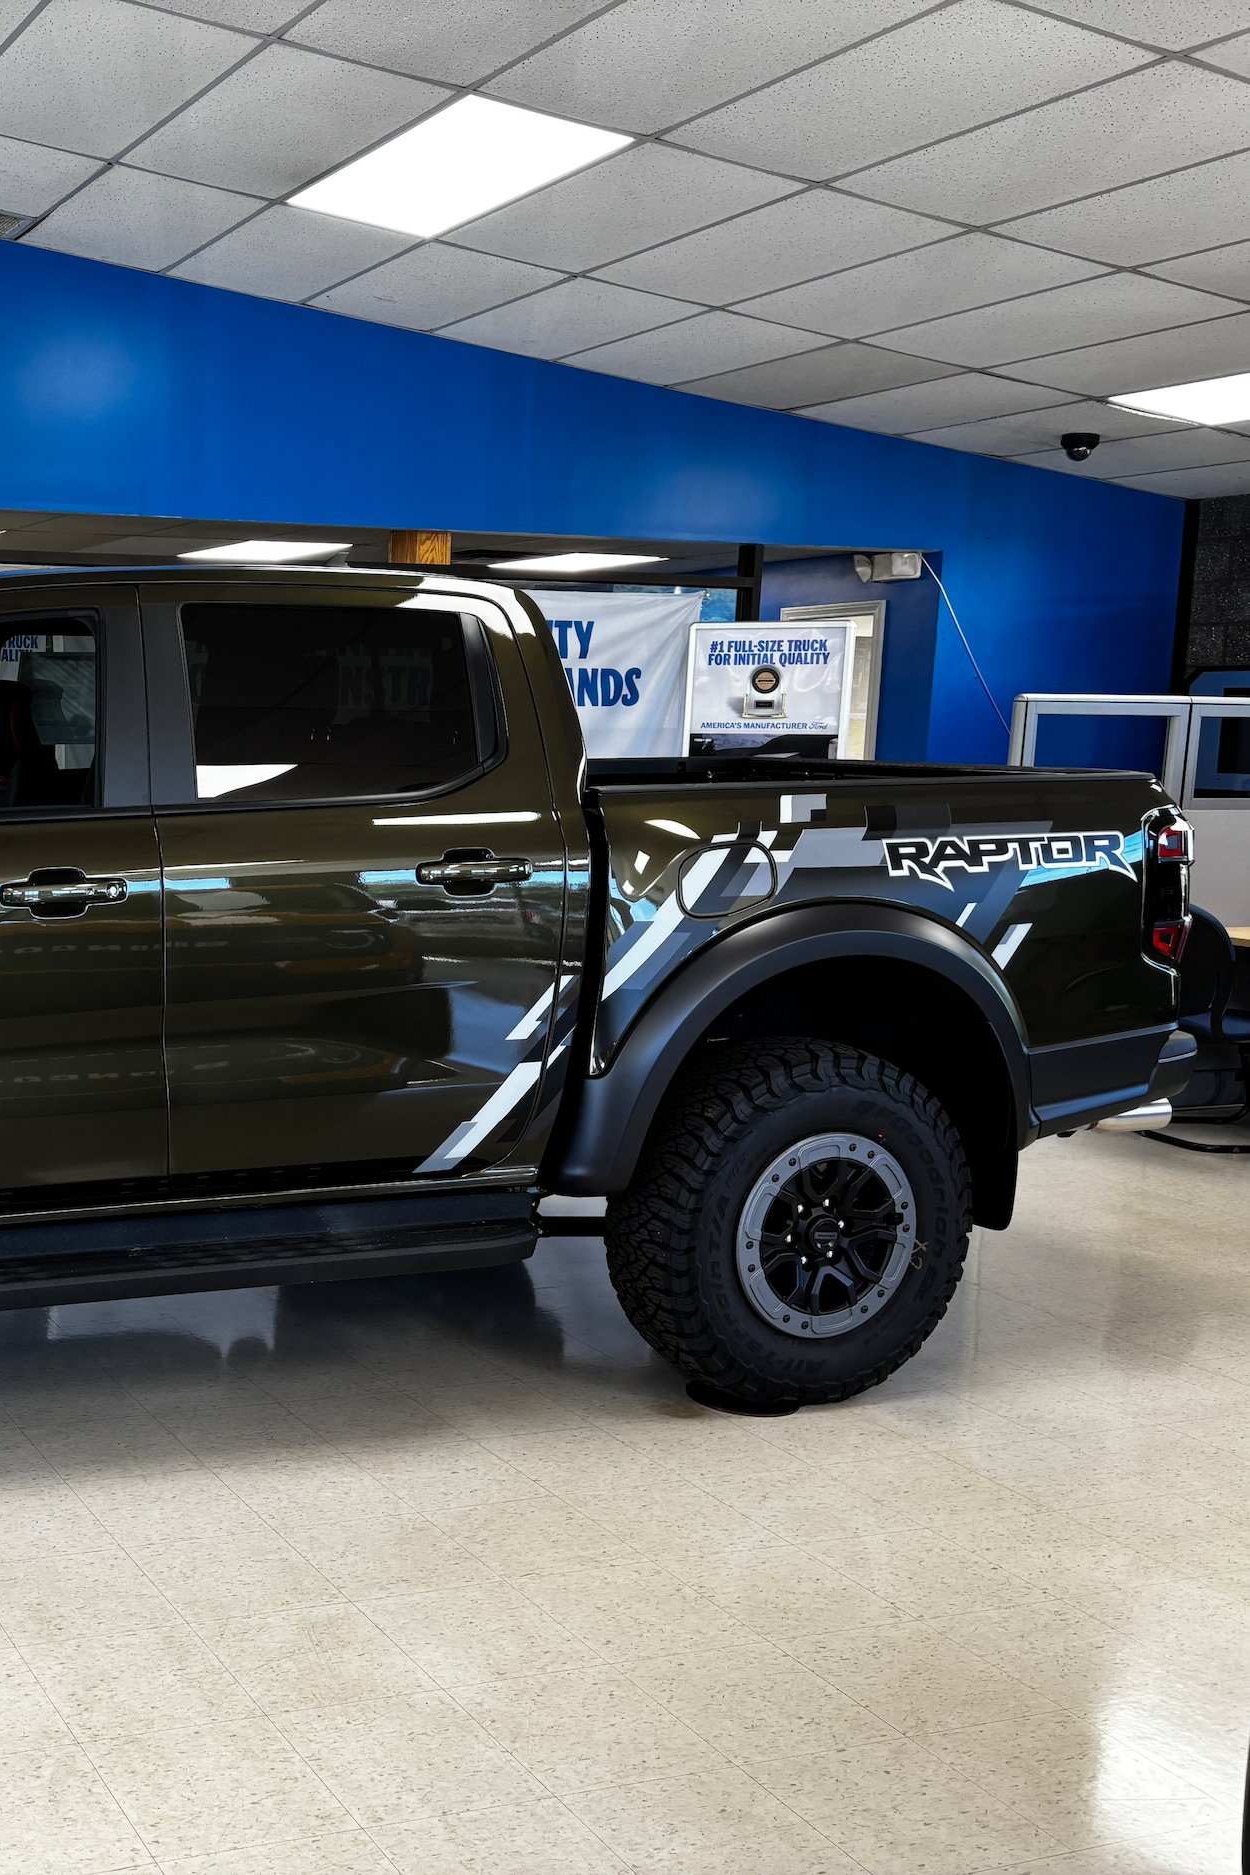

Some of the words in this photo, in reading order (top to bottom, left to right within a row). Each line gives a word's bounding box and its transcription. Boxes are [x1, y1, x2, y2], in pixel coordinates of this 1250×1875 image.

[4, 634, 38, 648] RUCK
[710, 641, 724, 653] #1
[728, 640, 784, 653] FULL-SIZE
[787, 639, 828, 652] TRUCK
[708, 653, 731, 666] FOR
[734, 653, 776, 665] INITIAL
[779, 652, 830, 667] QUALITY
[743, 722, 807, 730] MANUFACTURER
[809, 721, 828, 730] Ford
[882, 830, 1138, 892] RAPTOR
